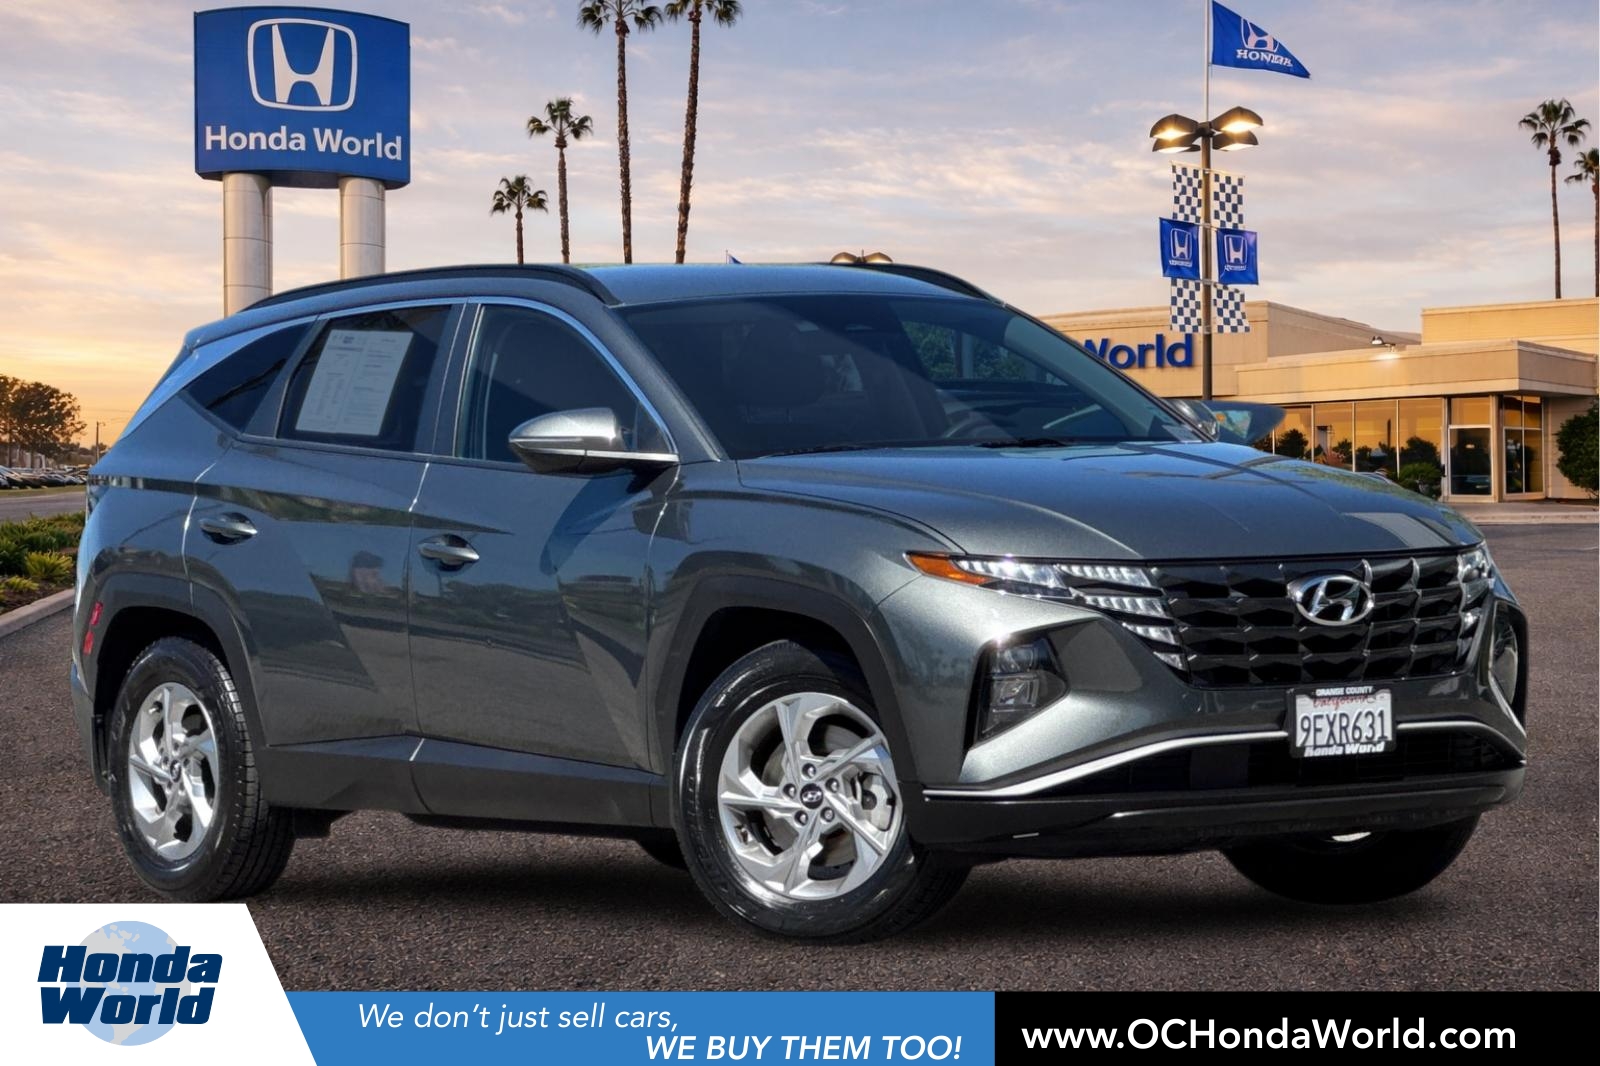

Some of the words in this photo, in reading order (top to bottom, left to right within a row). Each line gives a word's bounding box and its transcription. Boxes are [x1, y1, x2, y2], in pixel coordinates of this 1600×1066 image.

[205, 126, 306, 151] Honda
[313, 128, 402, 161] World
[1316, 687, 1345, 697] ORANGE
[1345, 686, 1373, 694] COUNTY
[1345, 741, 1386, 754] World
